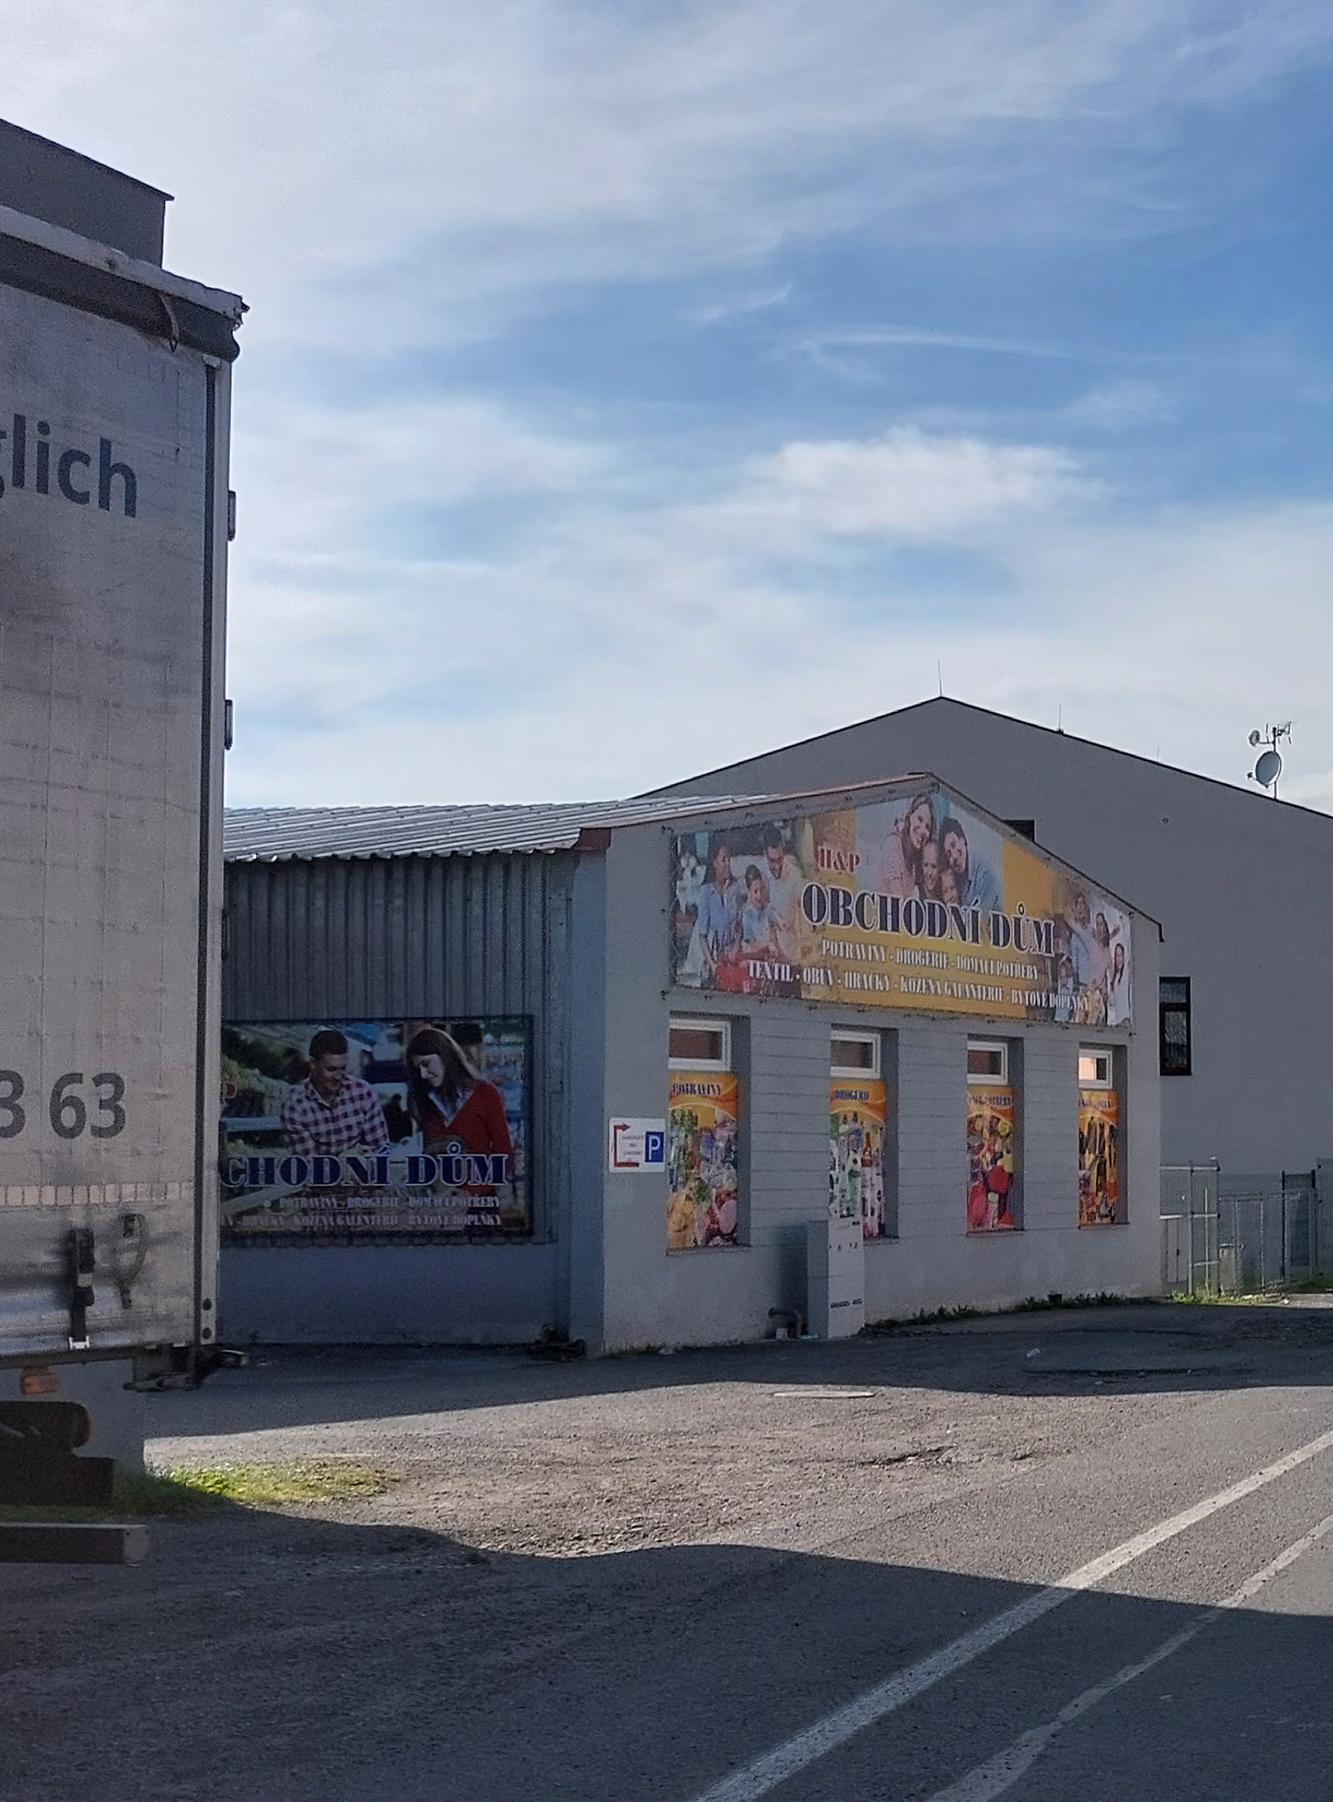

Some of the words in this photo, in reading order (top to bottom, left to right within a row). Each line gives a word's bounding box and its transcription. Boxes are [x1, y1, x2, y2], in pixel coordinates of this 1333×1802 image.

[0, 413, 137, 518] lich
[816, 846, 861, 873] H&P
[801, 881, 982, 947] OBCHODNÍ
[990, 902, 1056, 958] DŮM
[822, 939, 885, 962] POTRAVINY
[896, 947, 948, 970] DROGERIE
[748, 959, 793, 982] TEXTIL
[803, 966, 833, 986] OBUV
[844, 971, 890, 992] HRAČKY
[49, 1072, 126, 1140] 63
[220, 1144, 390, 1188] CHODNÍ
[406, 1142, 509, 1188] DŮM
[649, 1135, 661, 1161] P
